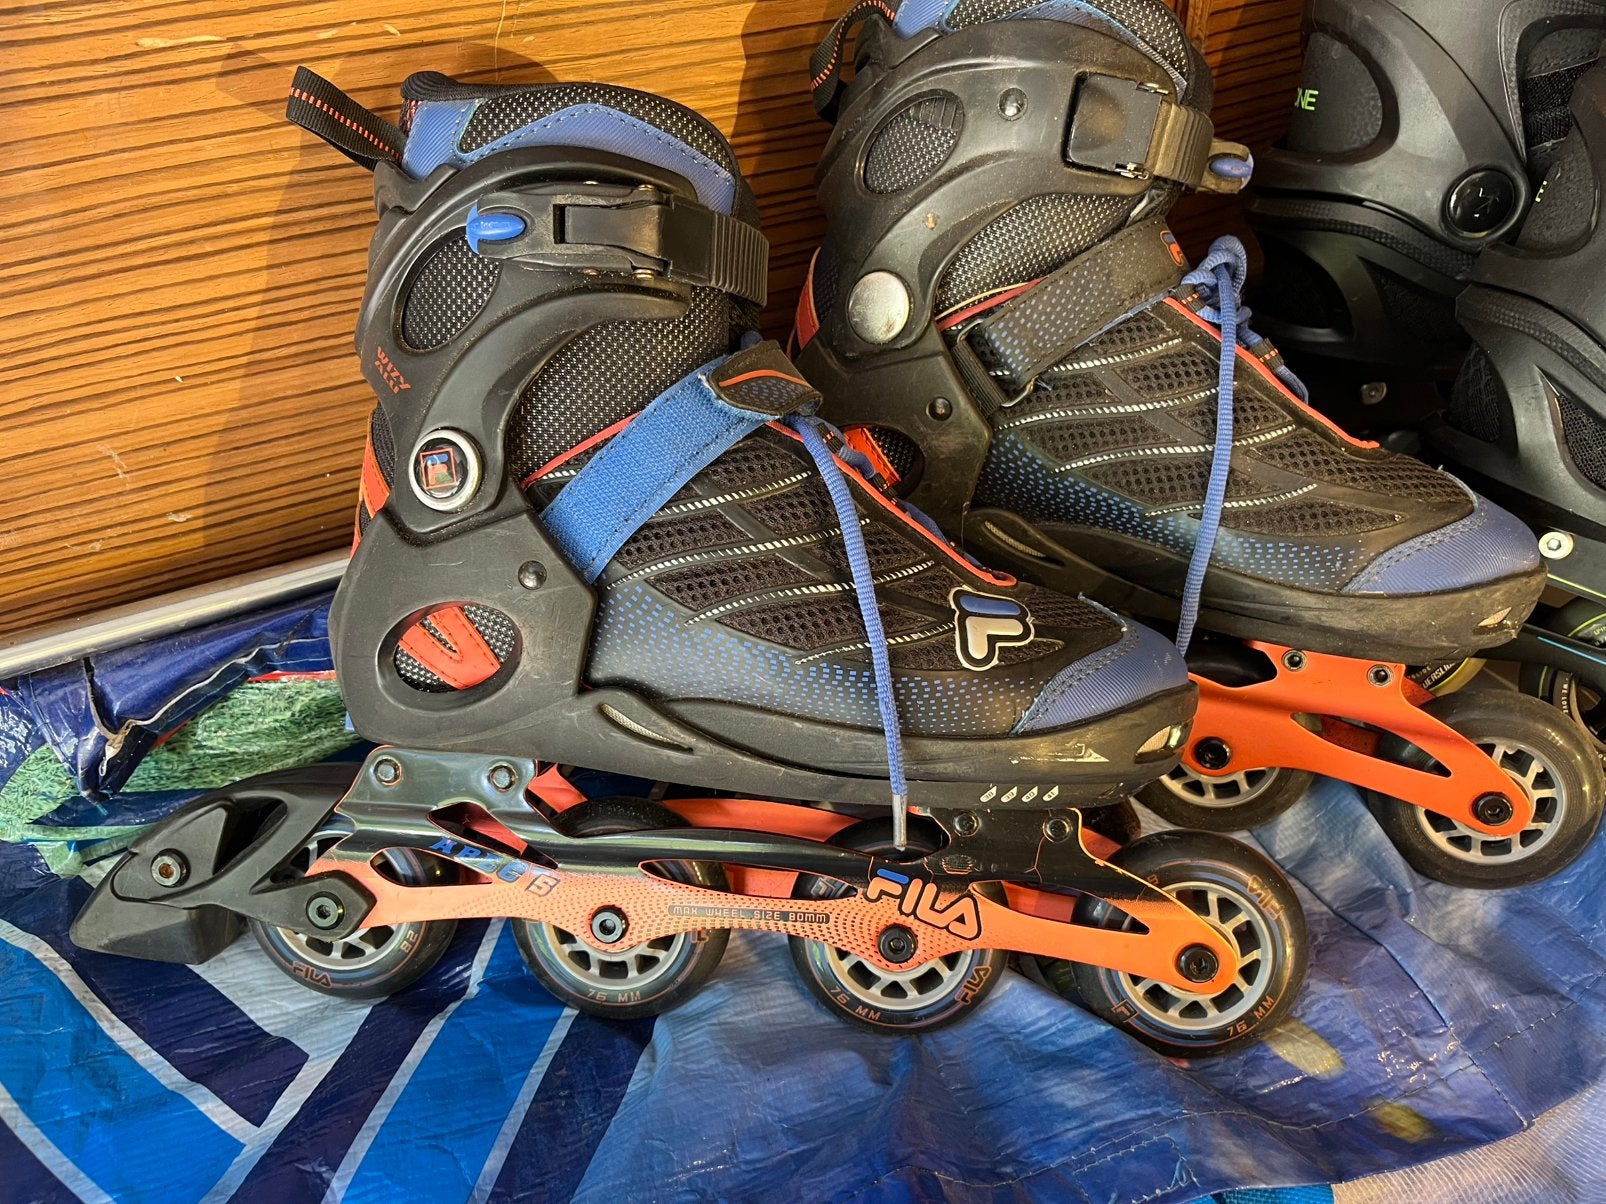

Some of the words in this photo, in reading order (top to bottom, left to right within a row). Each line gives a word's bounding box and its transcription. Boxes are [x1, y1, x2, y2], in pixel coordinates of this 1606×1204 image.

[1294, 87, 1319, 111] NE
[673, 906, 698, 916] MAX
[705, 908, 745, 918] WHEEL
[753, 910, 781, 921] SIZE
[865, 868, 982, 941] FILA
[1247, 874, 1284, 921] FILA
[292, 960, 333, 989] FILA
[954, 965, 992, 1005] FILA
[587, 988, 608, 1001] 76
[617, 990, 641, 1003] MM
[830, 985, 850, 1004] 76
[855, 1005, 881, 1021] MM
[1226, 1021, 1248, 1037] 76
[1253, 996, 1275, 1019] MM
